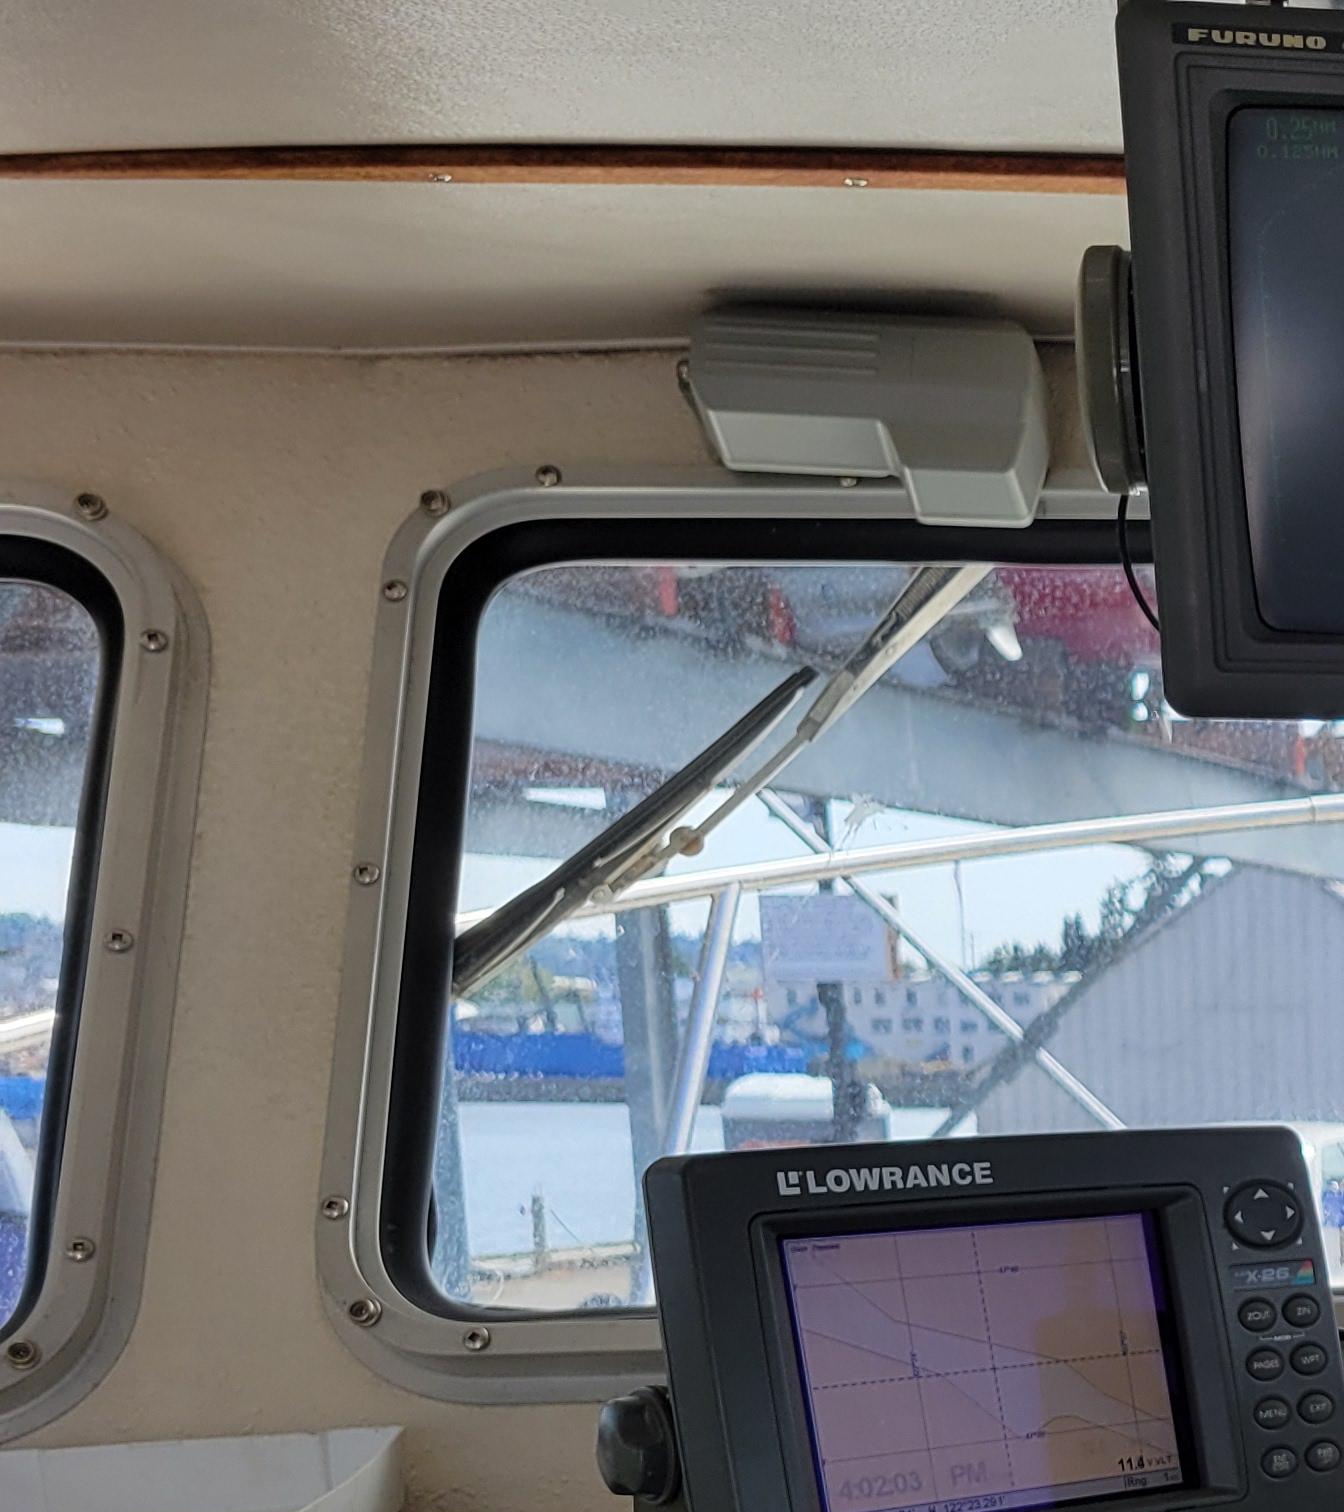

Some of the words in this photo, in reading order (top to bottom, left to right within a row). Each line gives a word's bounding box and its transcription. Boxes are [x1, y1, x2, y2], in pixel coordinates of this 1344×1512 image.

[1188, 28, 1326, 49] FURUNO
[806, 1162, 994, 1194] LOWRANCE
[951, 1462, 988, 1487] PM
[1118, 1456, 1145, 1471] 11.4
